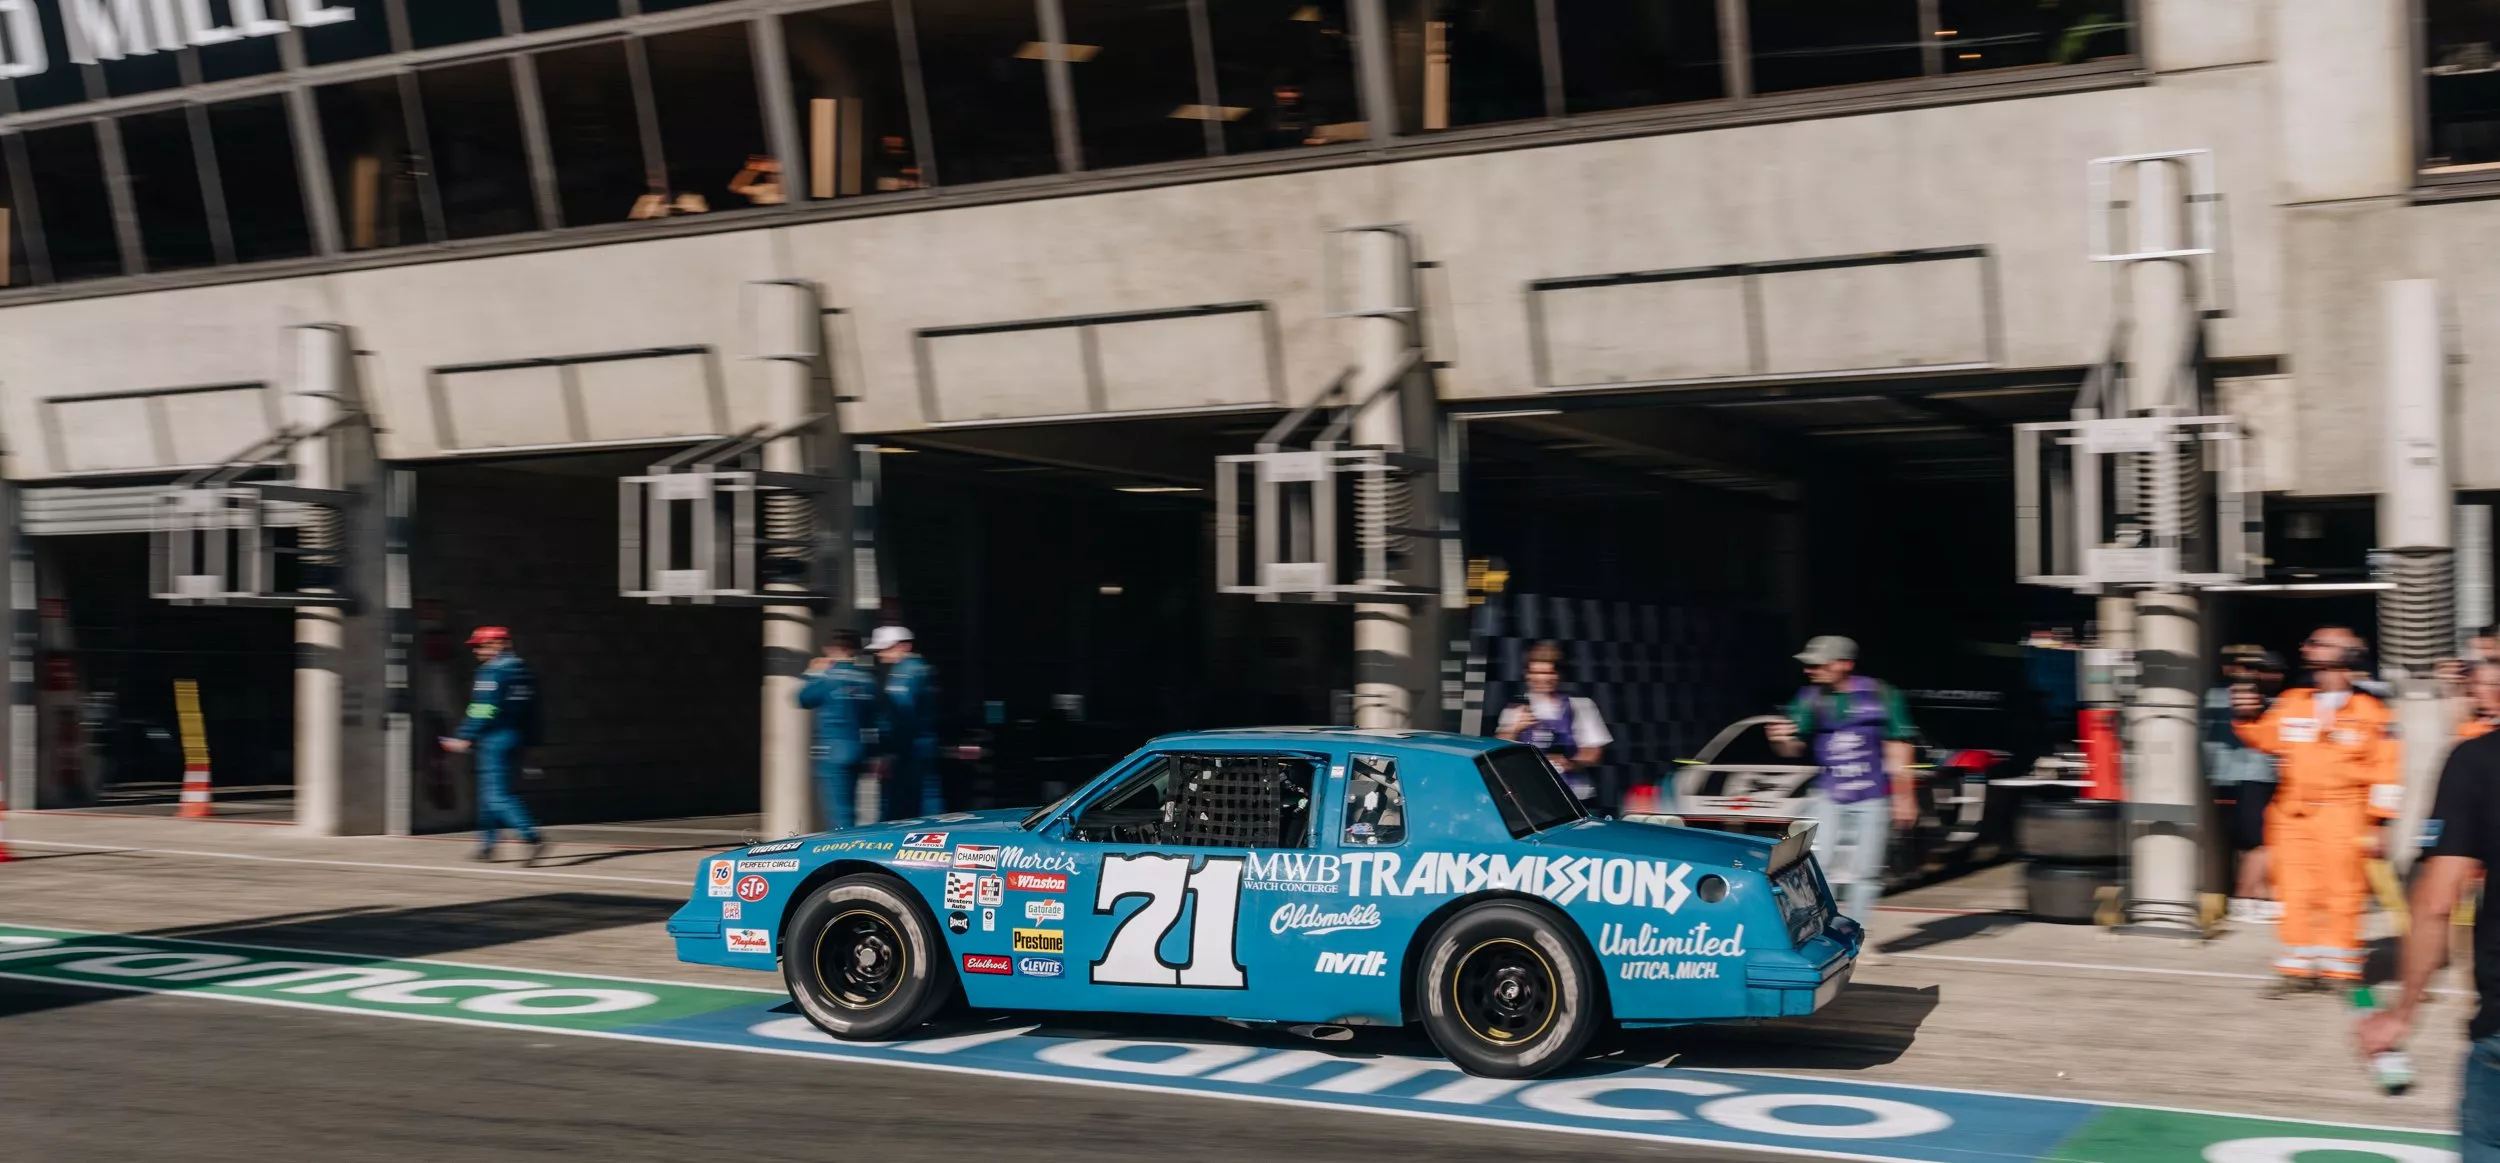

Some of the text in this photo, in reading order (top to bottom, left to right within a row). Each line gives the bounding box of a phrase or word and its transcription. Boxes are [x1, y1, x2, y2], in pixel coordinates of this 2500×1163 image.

[904, 833, 946, 845] JE
[895, 849, 953, 862] MOOG
[957, 852, 997, 862] CHAMPION
[1000, 845, 1082, 875] Marcis
[740, 860, 797, 869] PERFECT CIRCLE
[1244, 851, 1341, 883] MWB
[715, 867, 729, 879] 76
[740, 878, 765, 897] STP
[1017, 875, 1066, 890] Winston
[1243, 881, 1339, 894] WATCH CONCIERGE
[1341, 851, 1695, 915] TRANSMISSIONS
[1028, 904, 1062, 915] Gatorade
[1090, 852, 1249, 989] 71
[1269, 902, 1382, 935] Oldsmobile
[1014, 931, 1063, 951] Prestone
[1598, 922, 1746, 957] Unlimited
[967, 958, 1009, 970] Edelbrock
[1020, 957, 1060, 973] CLEVITE
[1619, 960, 1720, 980] UTICA, MICH.
